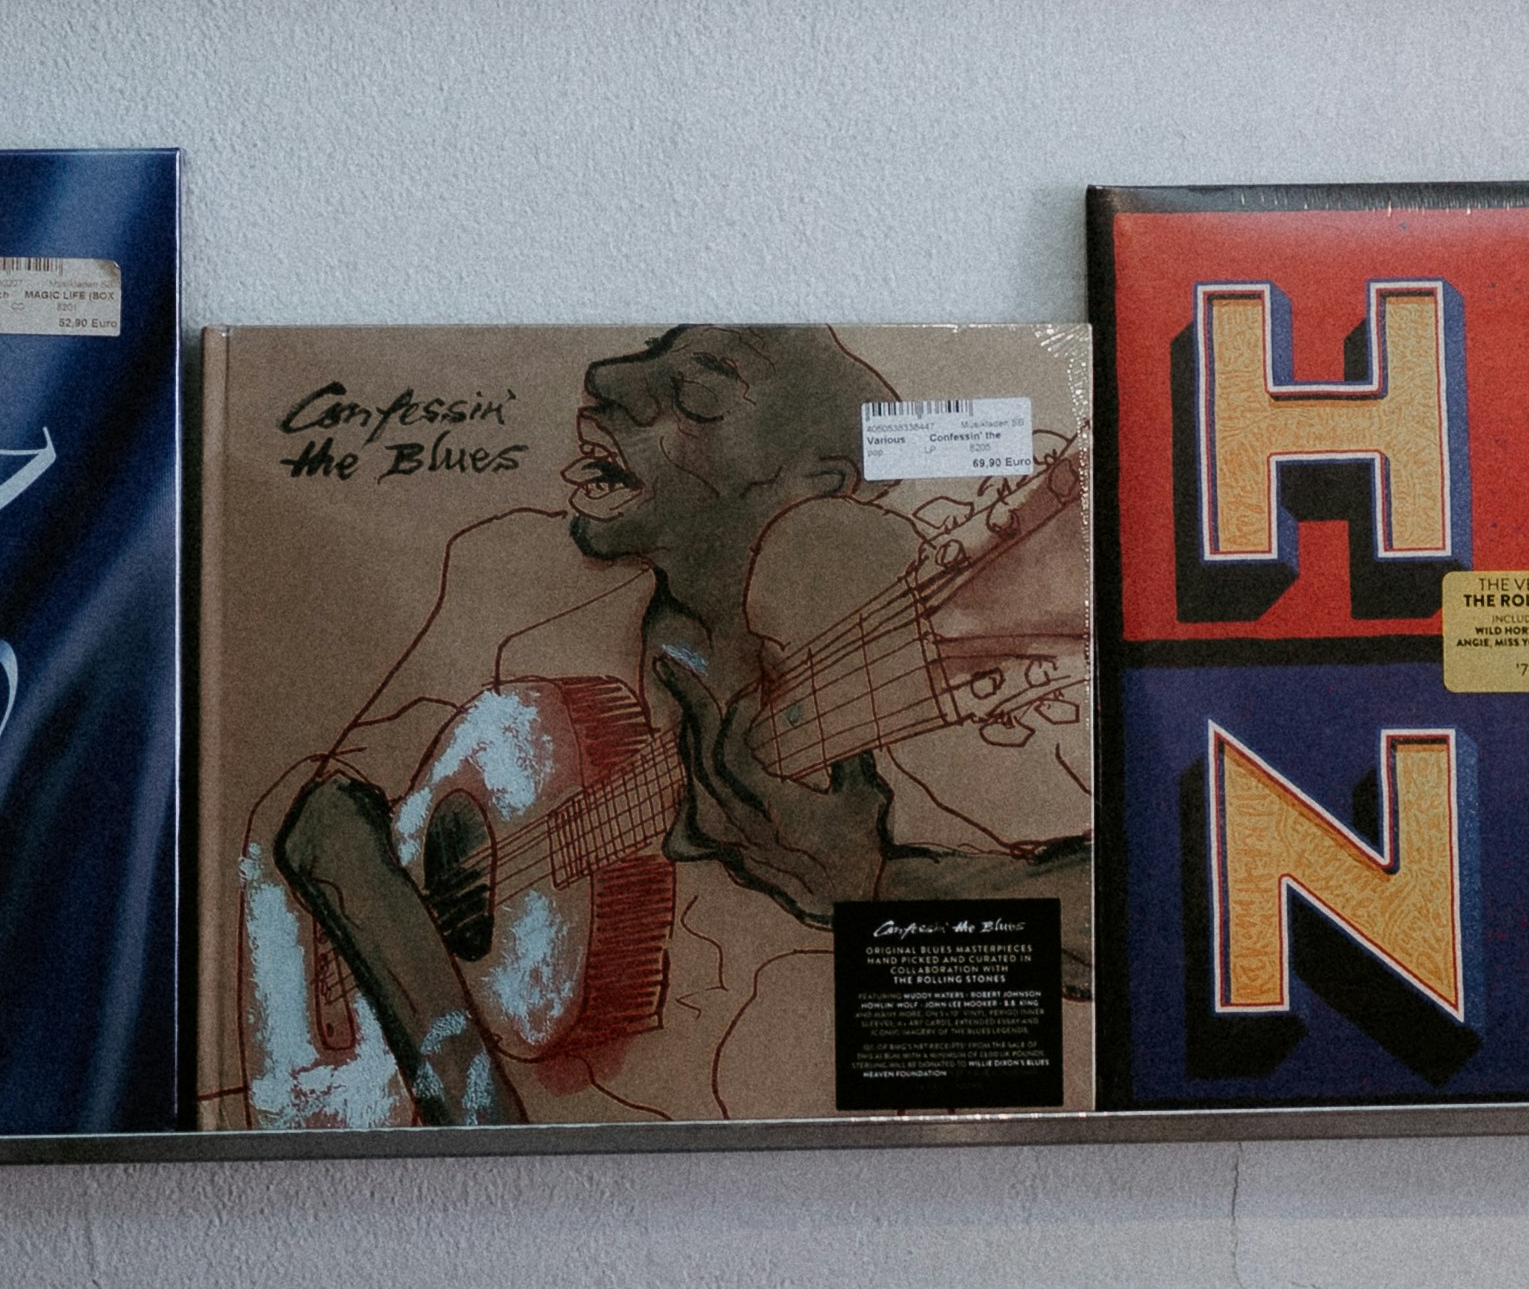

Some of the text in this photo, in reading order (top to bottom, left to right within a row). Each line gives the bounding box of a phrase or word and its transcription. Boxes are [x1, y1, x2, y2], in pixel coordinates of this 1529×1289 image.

[24, 291, 60, 300] MAGIC
[62, 292, 85, 300] LIFE
[88, 292, 115, 301] (BOX
[59, 318, 117, 328] 52,90 Euro
[276, 380, 517, 450] Confessin'
[867, 432, 1001, 445] Various Confessin' the
[279, 429, 529, 485] the Blues
[972, 458, 1031, 469] 69,90 Euro
[1479, 578, 1508, 591] THE
[1464, 594, 1496, 607] THE
[1475, 626, 1502, 636] WILD
[1456, 638, 1492, 648] ANGIE,
[1494, 638, 1519, 647] MISS
[865, 944, 1033, 955] ORIGINAL BLUES MASTERPIECES
[890, 965, 1009, 975] COLLABORATION WITH
[894, 974, 1006, 985] THE ROLLING STONES
